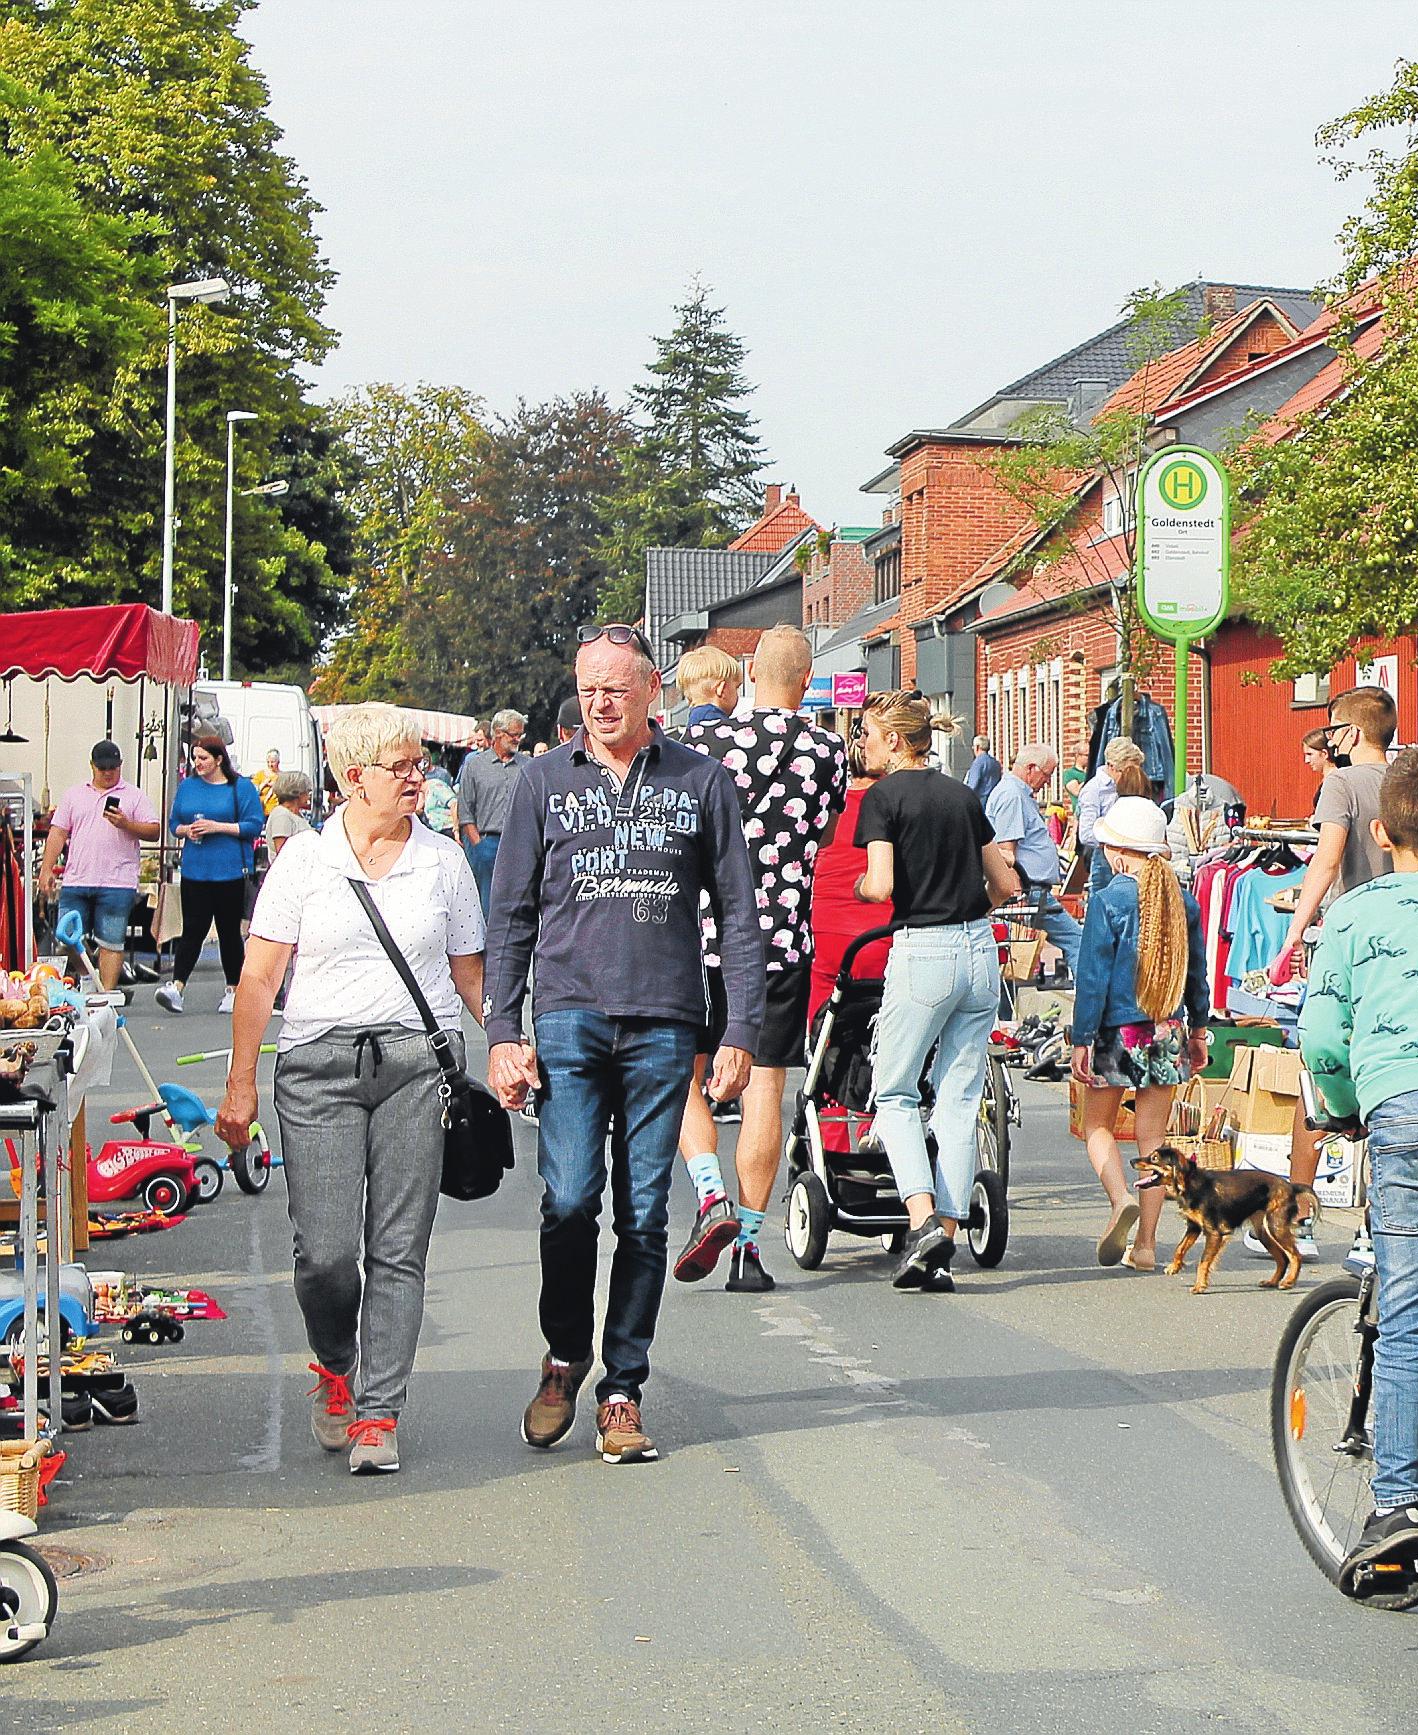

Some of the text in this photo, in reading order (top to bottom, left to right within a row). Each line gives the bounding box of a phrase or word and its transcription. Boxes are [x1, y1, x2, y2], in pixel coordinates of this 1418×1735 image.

[1151, 518, 1215, 528] Goldenstedt
[571, 848, 629, 874] PORT
[631, 844, 682, 856] LIGHTHOUSE
[570, 871, 680, 896] Bermuda
[632, 897, 669, 925] 63
